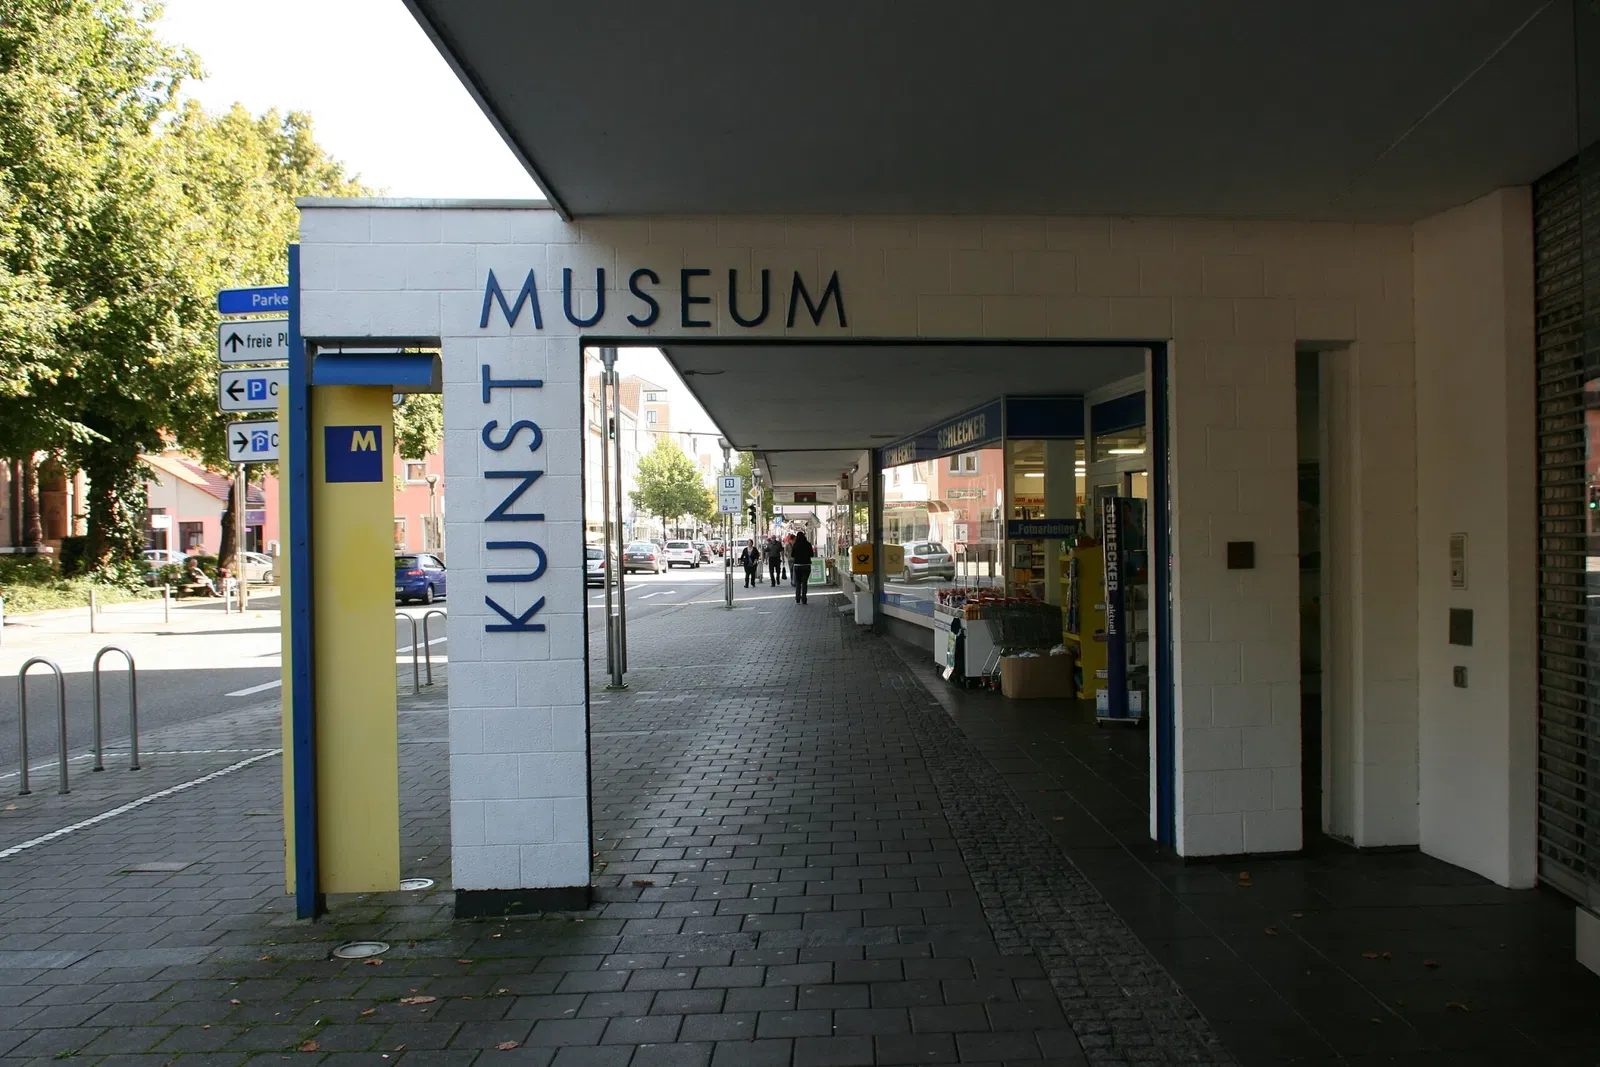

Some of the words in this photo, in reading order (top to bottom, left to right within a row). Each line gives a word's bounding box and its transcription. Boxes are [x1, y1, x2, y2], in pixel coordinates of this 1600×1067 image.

[480, 268, 848, 329] MUSEUM
[247, 334, 273, 349] freie
[251, 382, 262, 397] P
[350, 430, 377, 452] M
[937, 413, 986, 451] SCHLECKER
[885, 441, 917, 467] SCHLECKER
[481, 364, 548, 632] KUNST
[1105, 503, 1119, 592] SCHLECKER
[1109, 604, 1117, 635] aktuell
